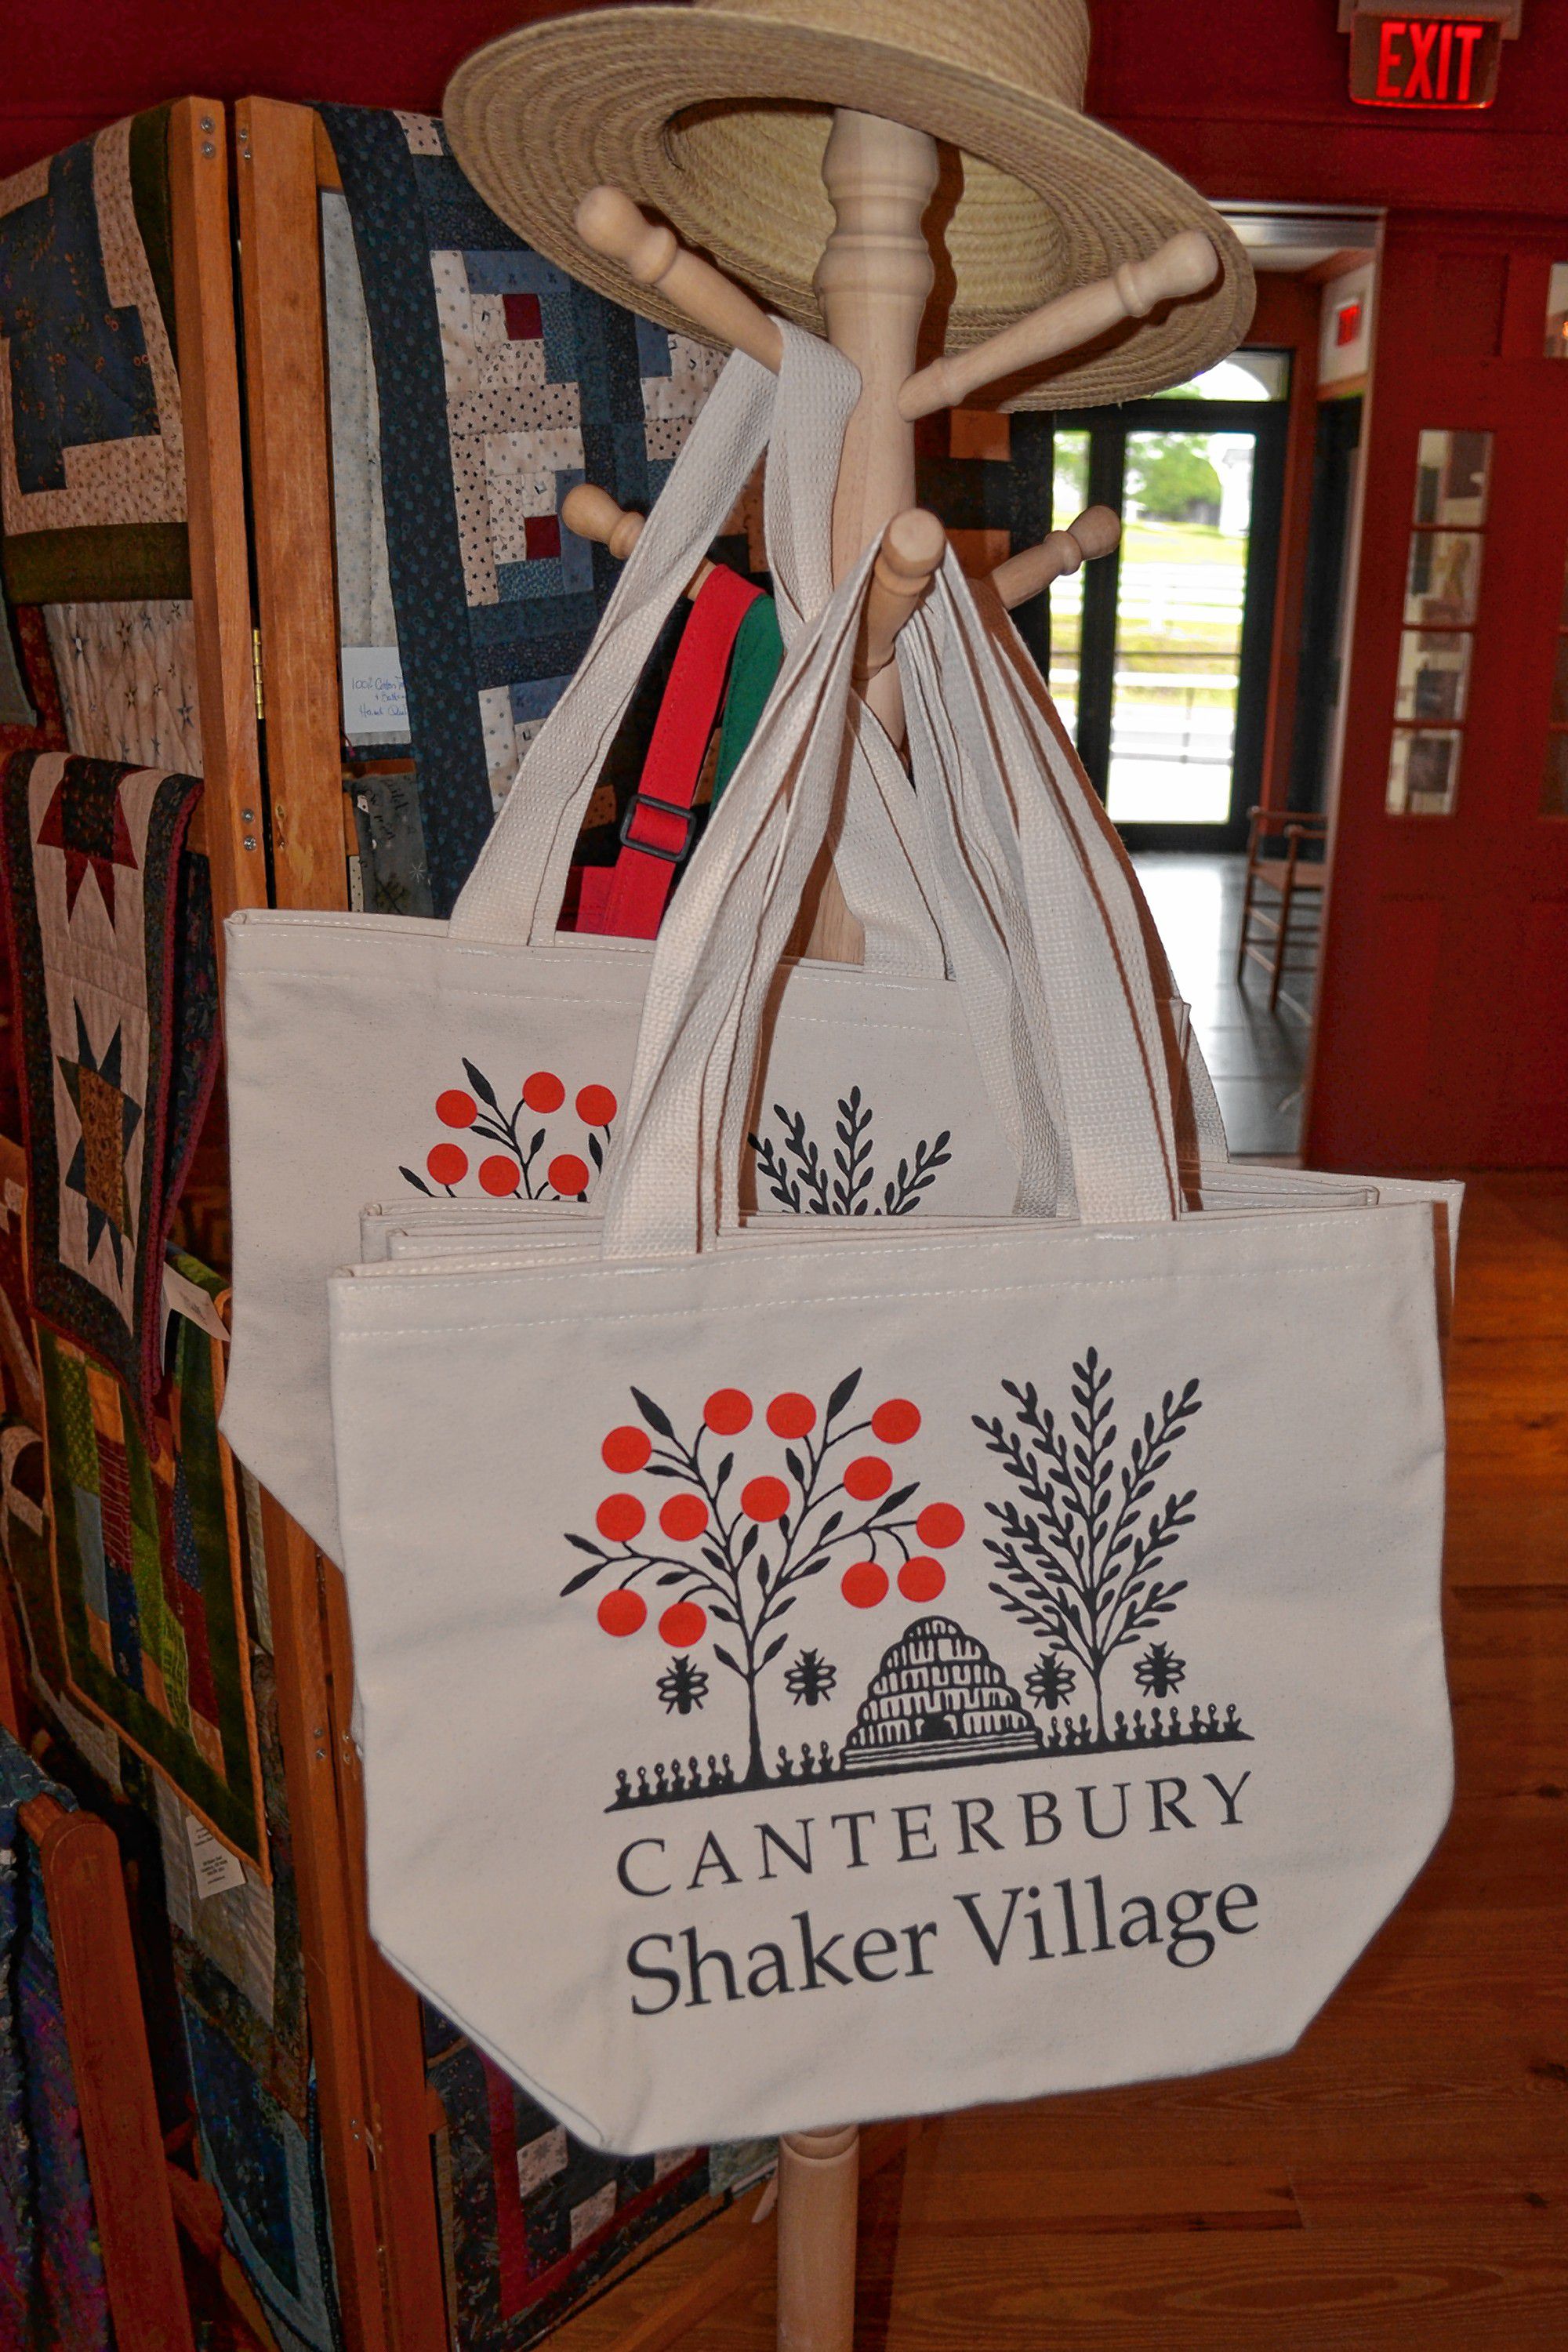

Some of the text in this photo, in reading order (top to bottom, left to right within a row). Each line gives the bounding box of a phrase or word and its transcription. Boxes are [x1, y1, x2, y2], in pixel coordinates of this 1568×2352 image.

[1376, 21, 1483, 101] EXIT
[616, 1770, 1252, 1898] CANTERBURY
[626, 1874, 1260, 2016] Shaker Village
